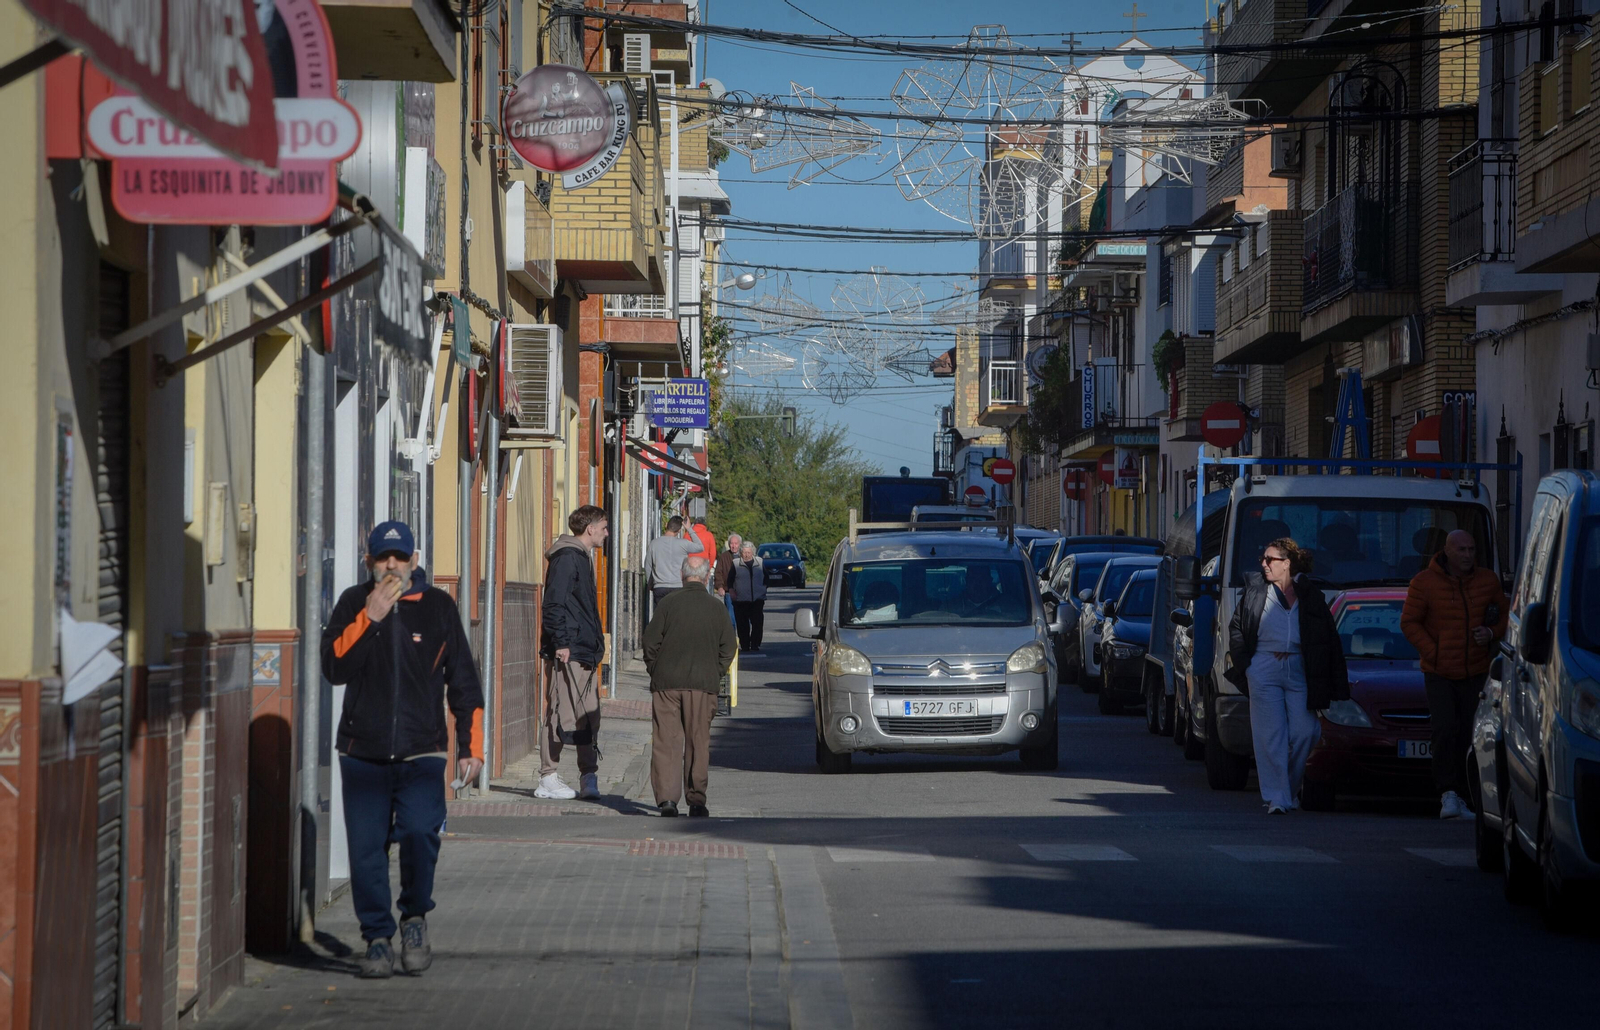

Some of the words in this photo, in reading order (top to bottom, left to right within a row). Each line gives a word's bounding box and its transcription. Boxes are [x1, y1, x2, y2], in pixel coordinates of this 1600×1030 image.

[295, 10, 323, 90] CERVEZAS
[615, 103, 626, 117] FU
[110, 107, 338, 153] Crupo
[510, 116, 605, 138] Cruzcampo
[612, 119, 626, 149] KUNG
[558, 142, 580, 150] 1904
[598, 149, 617, 170] BAR
[124, 170, 142, 194] LA
[150, 170, 232, 198] ESQUINITA
[241, 170, 258, 194] DE
[266, 170, 324, 194] JHONNY
[575, 165, 601, 184] CAFE
[654, 397, 676, 405] LIBRRÍA
[679, 398, 705, 406] PAPELERÍA
[1084, 367, 1093, 428] CHURROS
[664, 416, 694, 424] DROGUERÍA
[680, 407, 686, 415] DE
[1352, 616, 1381, 625] 251
[912, 702, 944, 715] 5727
[949, 702, 974, 714] GFJ
